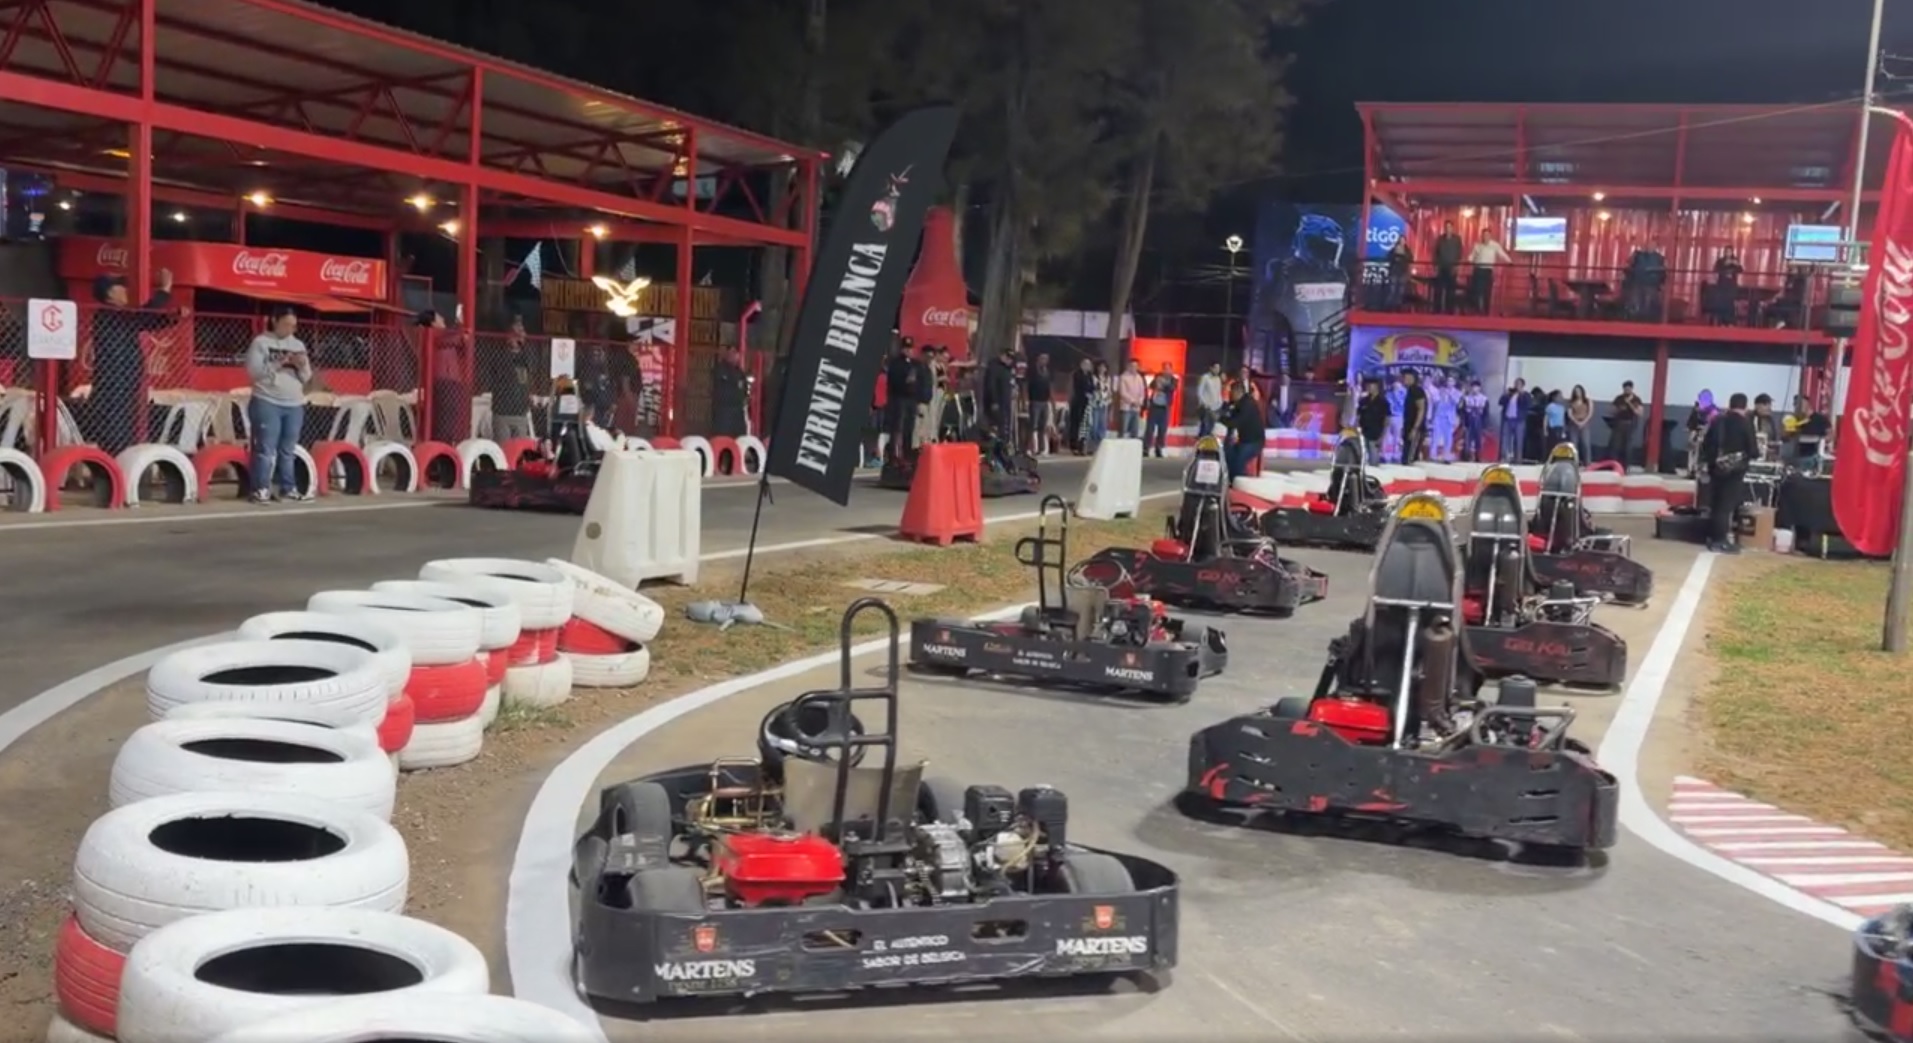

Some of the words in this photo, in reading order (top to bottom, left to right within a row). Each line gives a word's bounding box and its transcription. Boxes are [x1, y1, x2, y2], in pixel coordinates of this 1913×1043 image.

[795, 357, 851, 476] FERNET
[824, 242, 888, 355] BRANCA
[924, 643, 966, 658] MARTENS
[1105, 667, 1154, 681] MARTENS
[1056, 936, 1148, 955] MARTENS
[654, 959, 756, 980] MARTENS
